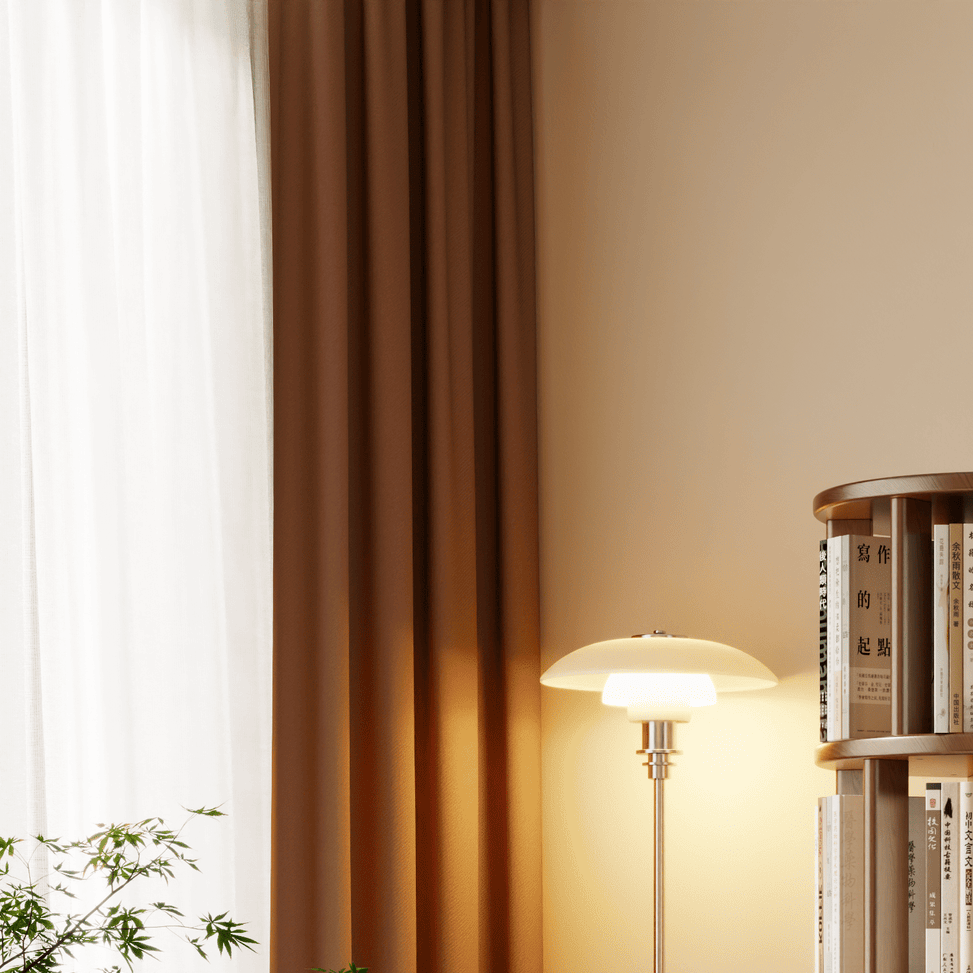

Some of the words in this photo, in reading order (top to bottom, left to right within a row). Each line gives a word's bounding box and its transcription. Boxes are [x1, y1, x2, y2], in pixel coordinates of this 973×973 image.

[951, 541, 961, 590] 余秋雨散文
[857, 590, 870, 610] 的
